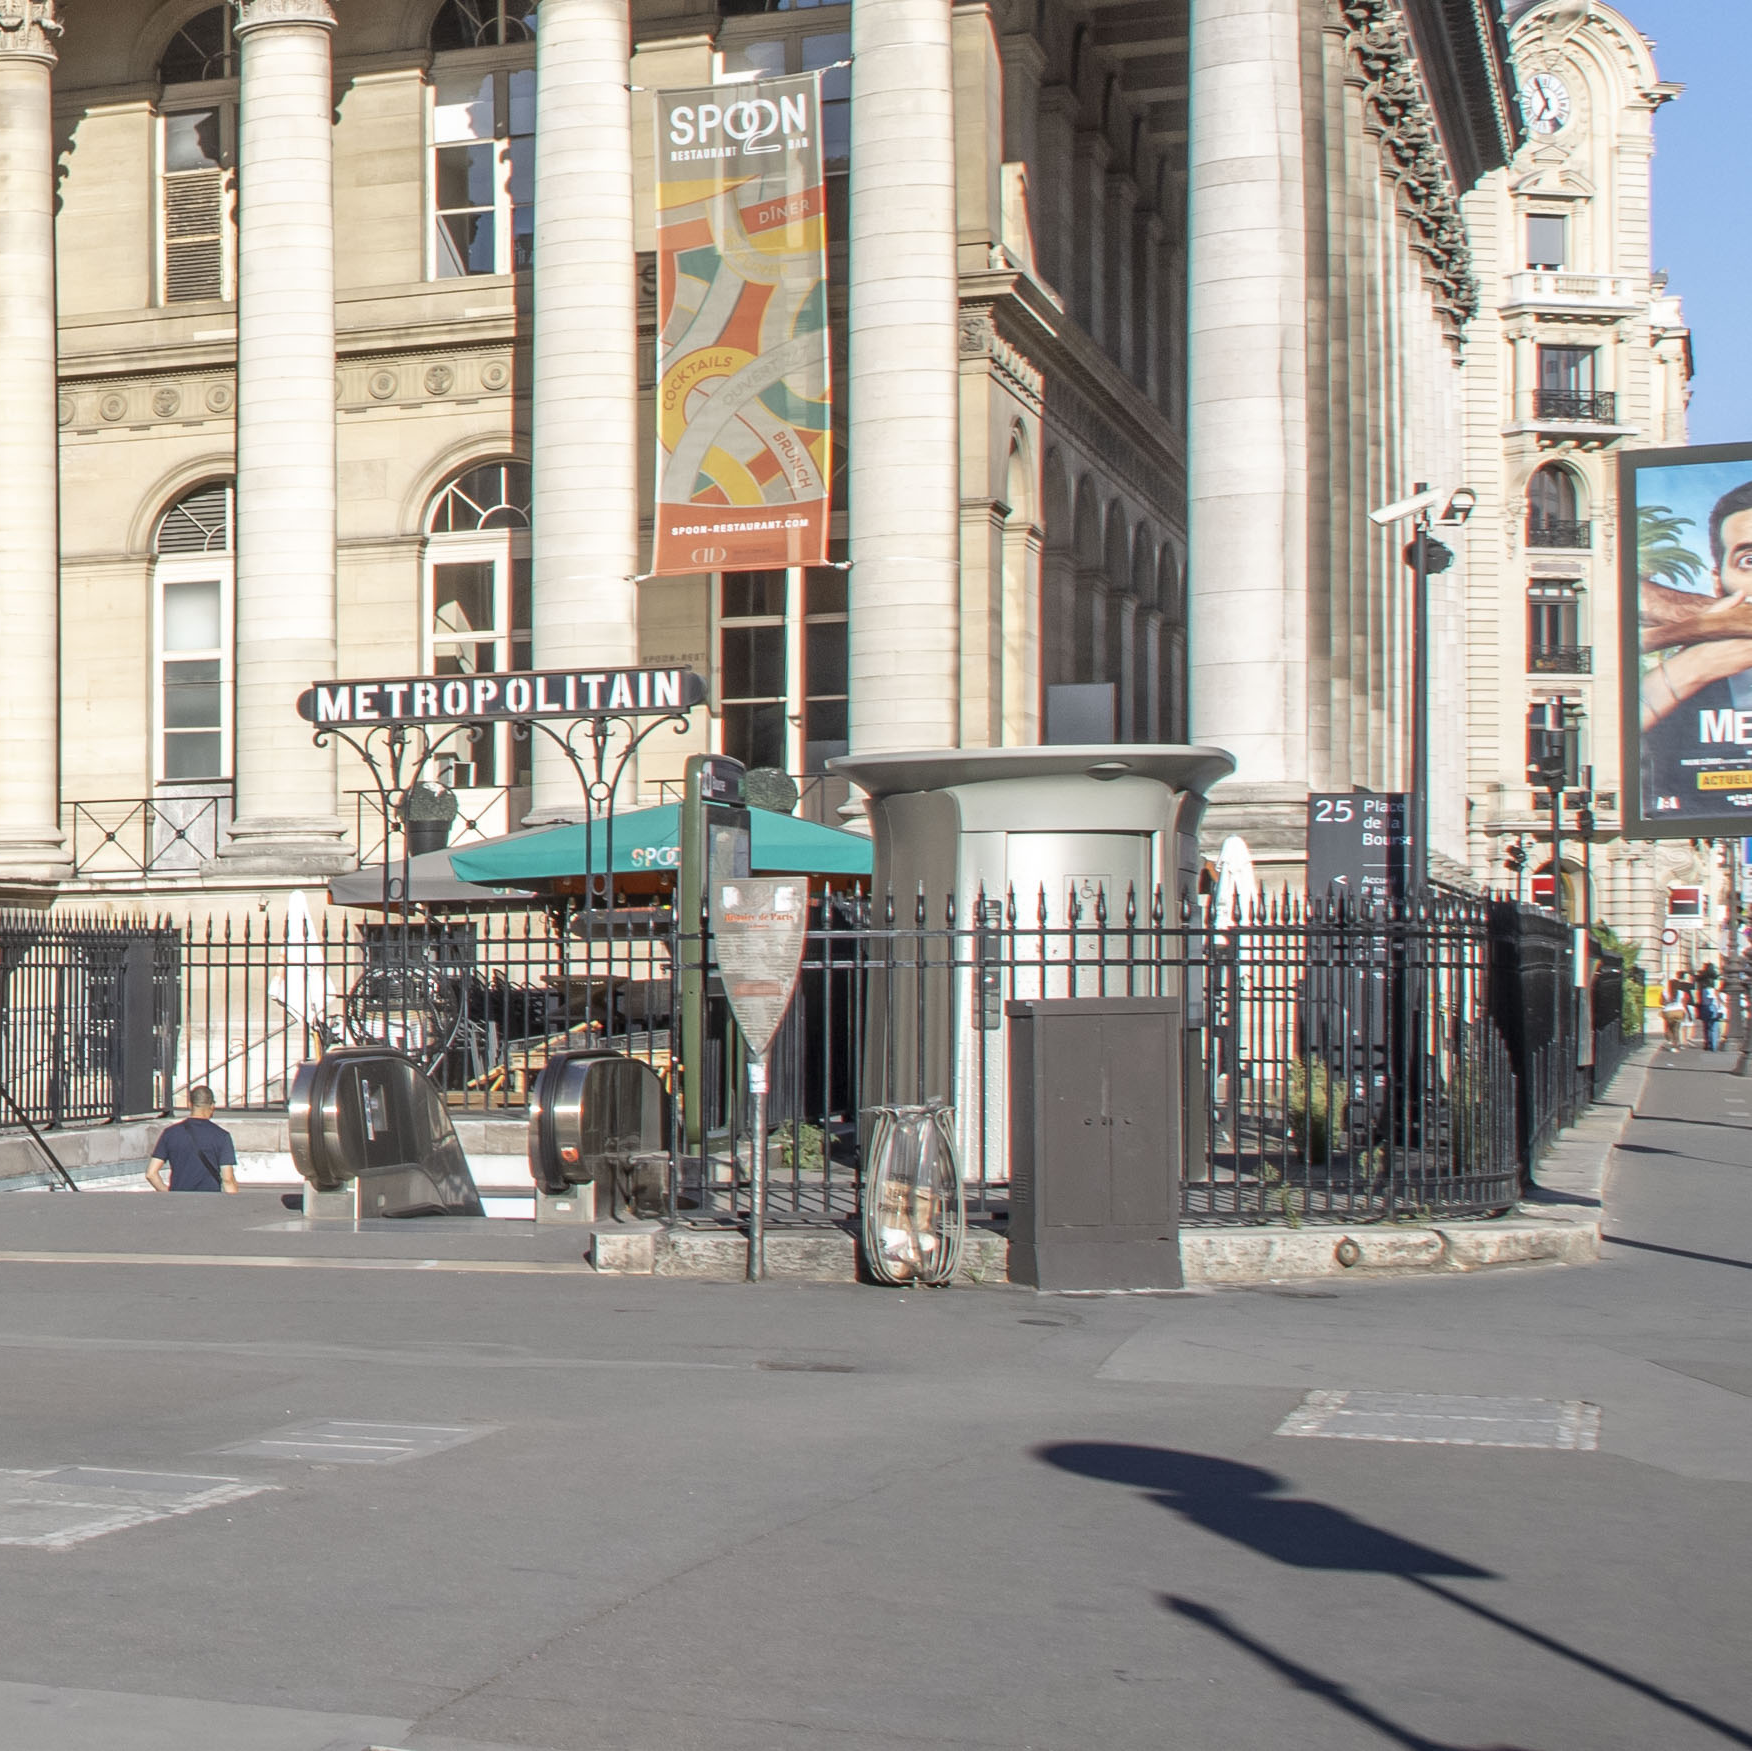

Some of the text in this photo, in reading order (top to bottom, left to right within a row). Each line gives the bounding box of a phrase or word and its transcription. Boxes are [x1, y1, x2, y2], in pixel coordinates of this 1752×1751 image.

[670, 137, 809, 162] RESTAURANT BAR
[758, 199, 810, 225] DÎNER
[663, 355, 733, 411] COCKTAILS
[773, 431, 813, 489] BRUNCH
[671, 518, 810, 537] SPOON-RESTAURANT.COM
[317, 670, 682, 722] METROPOLITAIN
[1315, 799, 1354, 823] 25
[1363, 816, 1382, 829] de
[1362, 832, 1414, 846] Bourse
[770, 912, 794, 922] Paris
